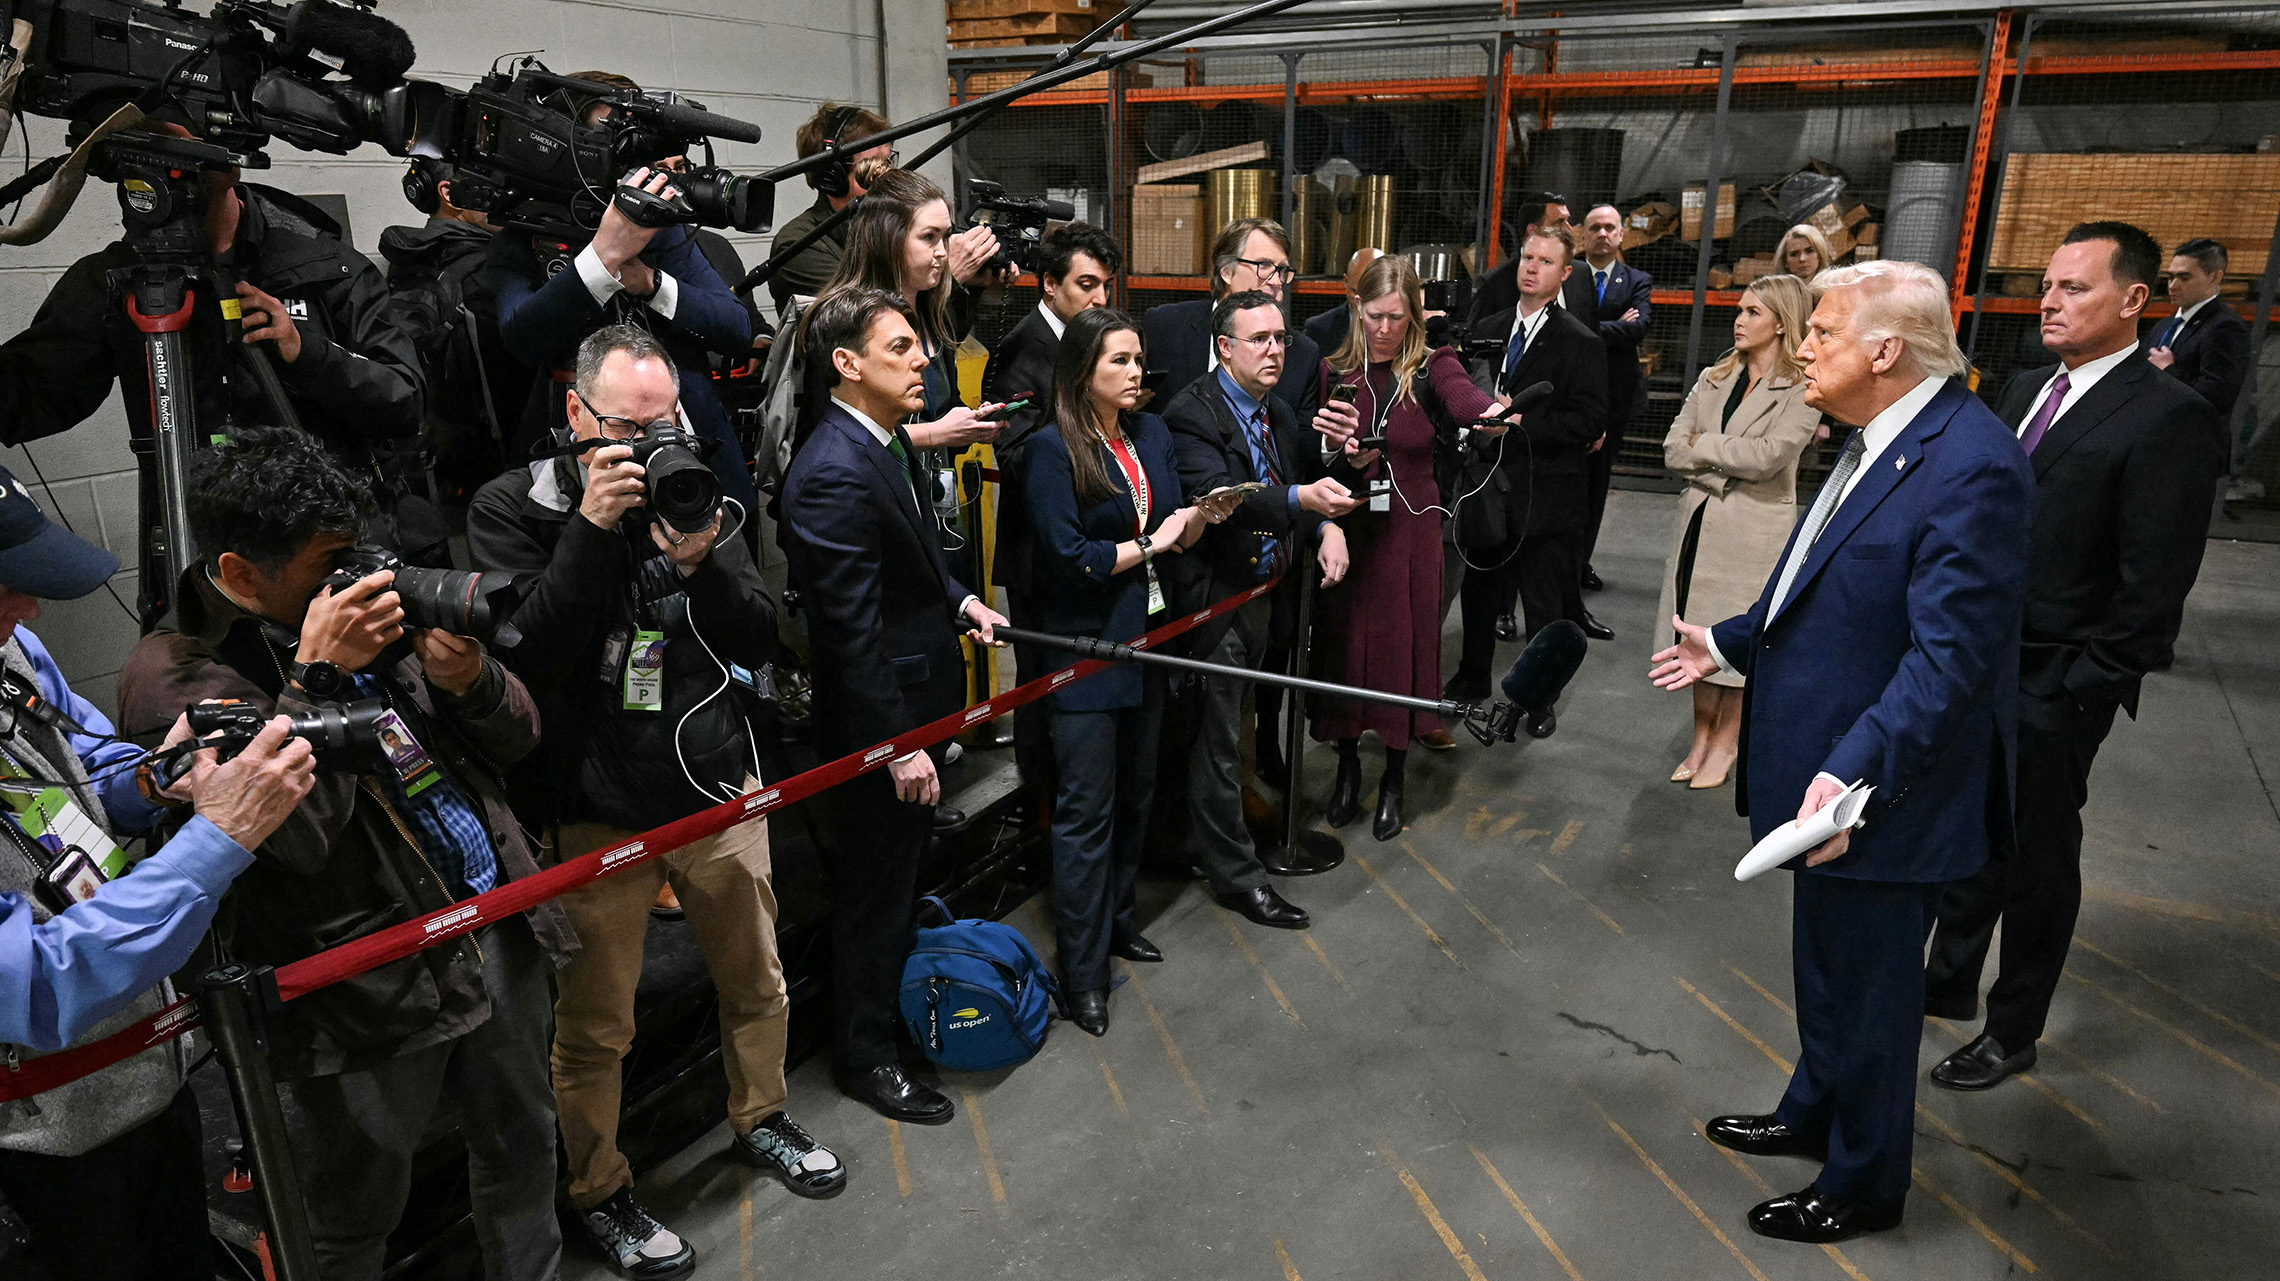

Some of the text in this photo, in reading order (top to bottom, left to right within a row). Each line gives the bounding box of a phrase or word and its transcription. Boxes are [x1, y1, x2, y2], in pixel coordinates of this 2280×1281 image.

[165, 37, 210, 54] Panasoc
[180, 70, 209, 83] PHD
[530, 132, 552, 147] CAMERA
[578, 150, 599, 158] SONY
[620, 192, 641, 205] Canon
[155, 340, 173, 432] sachtler flowtech
[639, 689, 649, 701] P
[409, 758, 425, 771] PRESS
[949, 1015, 990, 1030] us open
